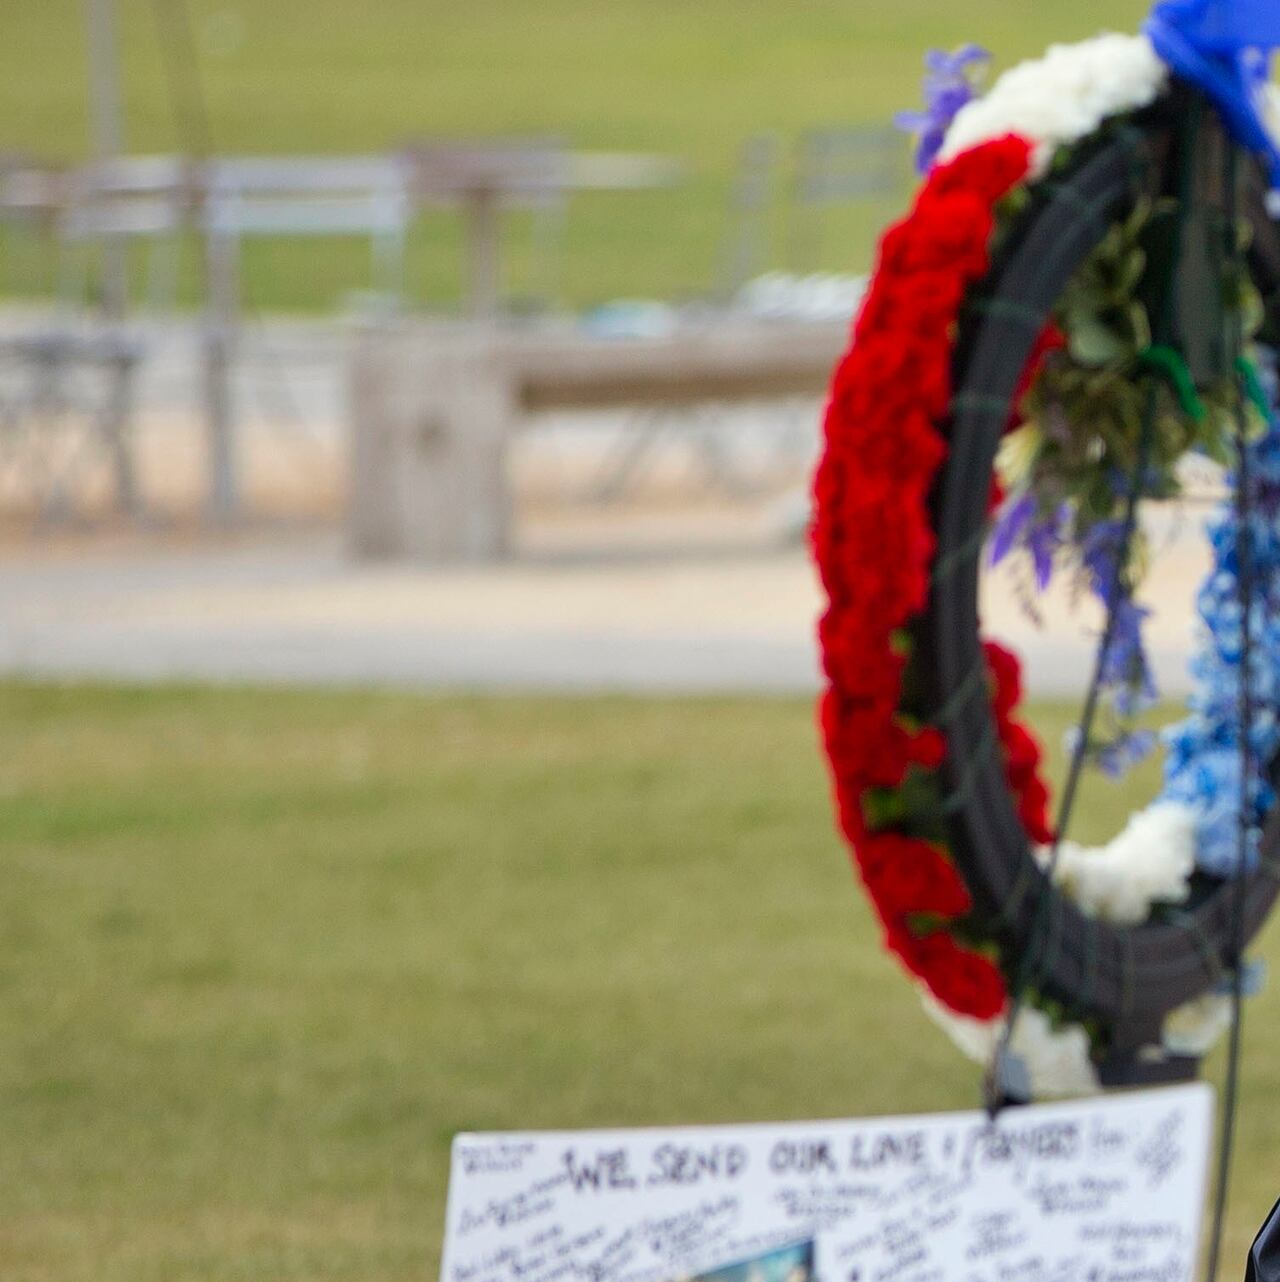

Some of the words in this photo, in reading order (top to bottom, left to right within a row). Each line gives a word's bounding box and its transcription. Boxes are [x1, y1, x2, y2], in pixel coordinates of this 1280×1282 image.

[562, 1147, 636, 1192] WE
[647, 1141, 748, 1184] SEND
[768, 1137, 837, 1174] OUR
[848, 1130, 925, 1171] LOVE
